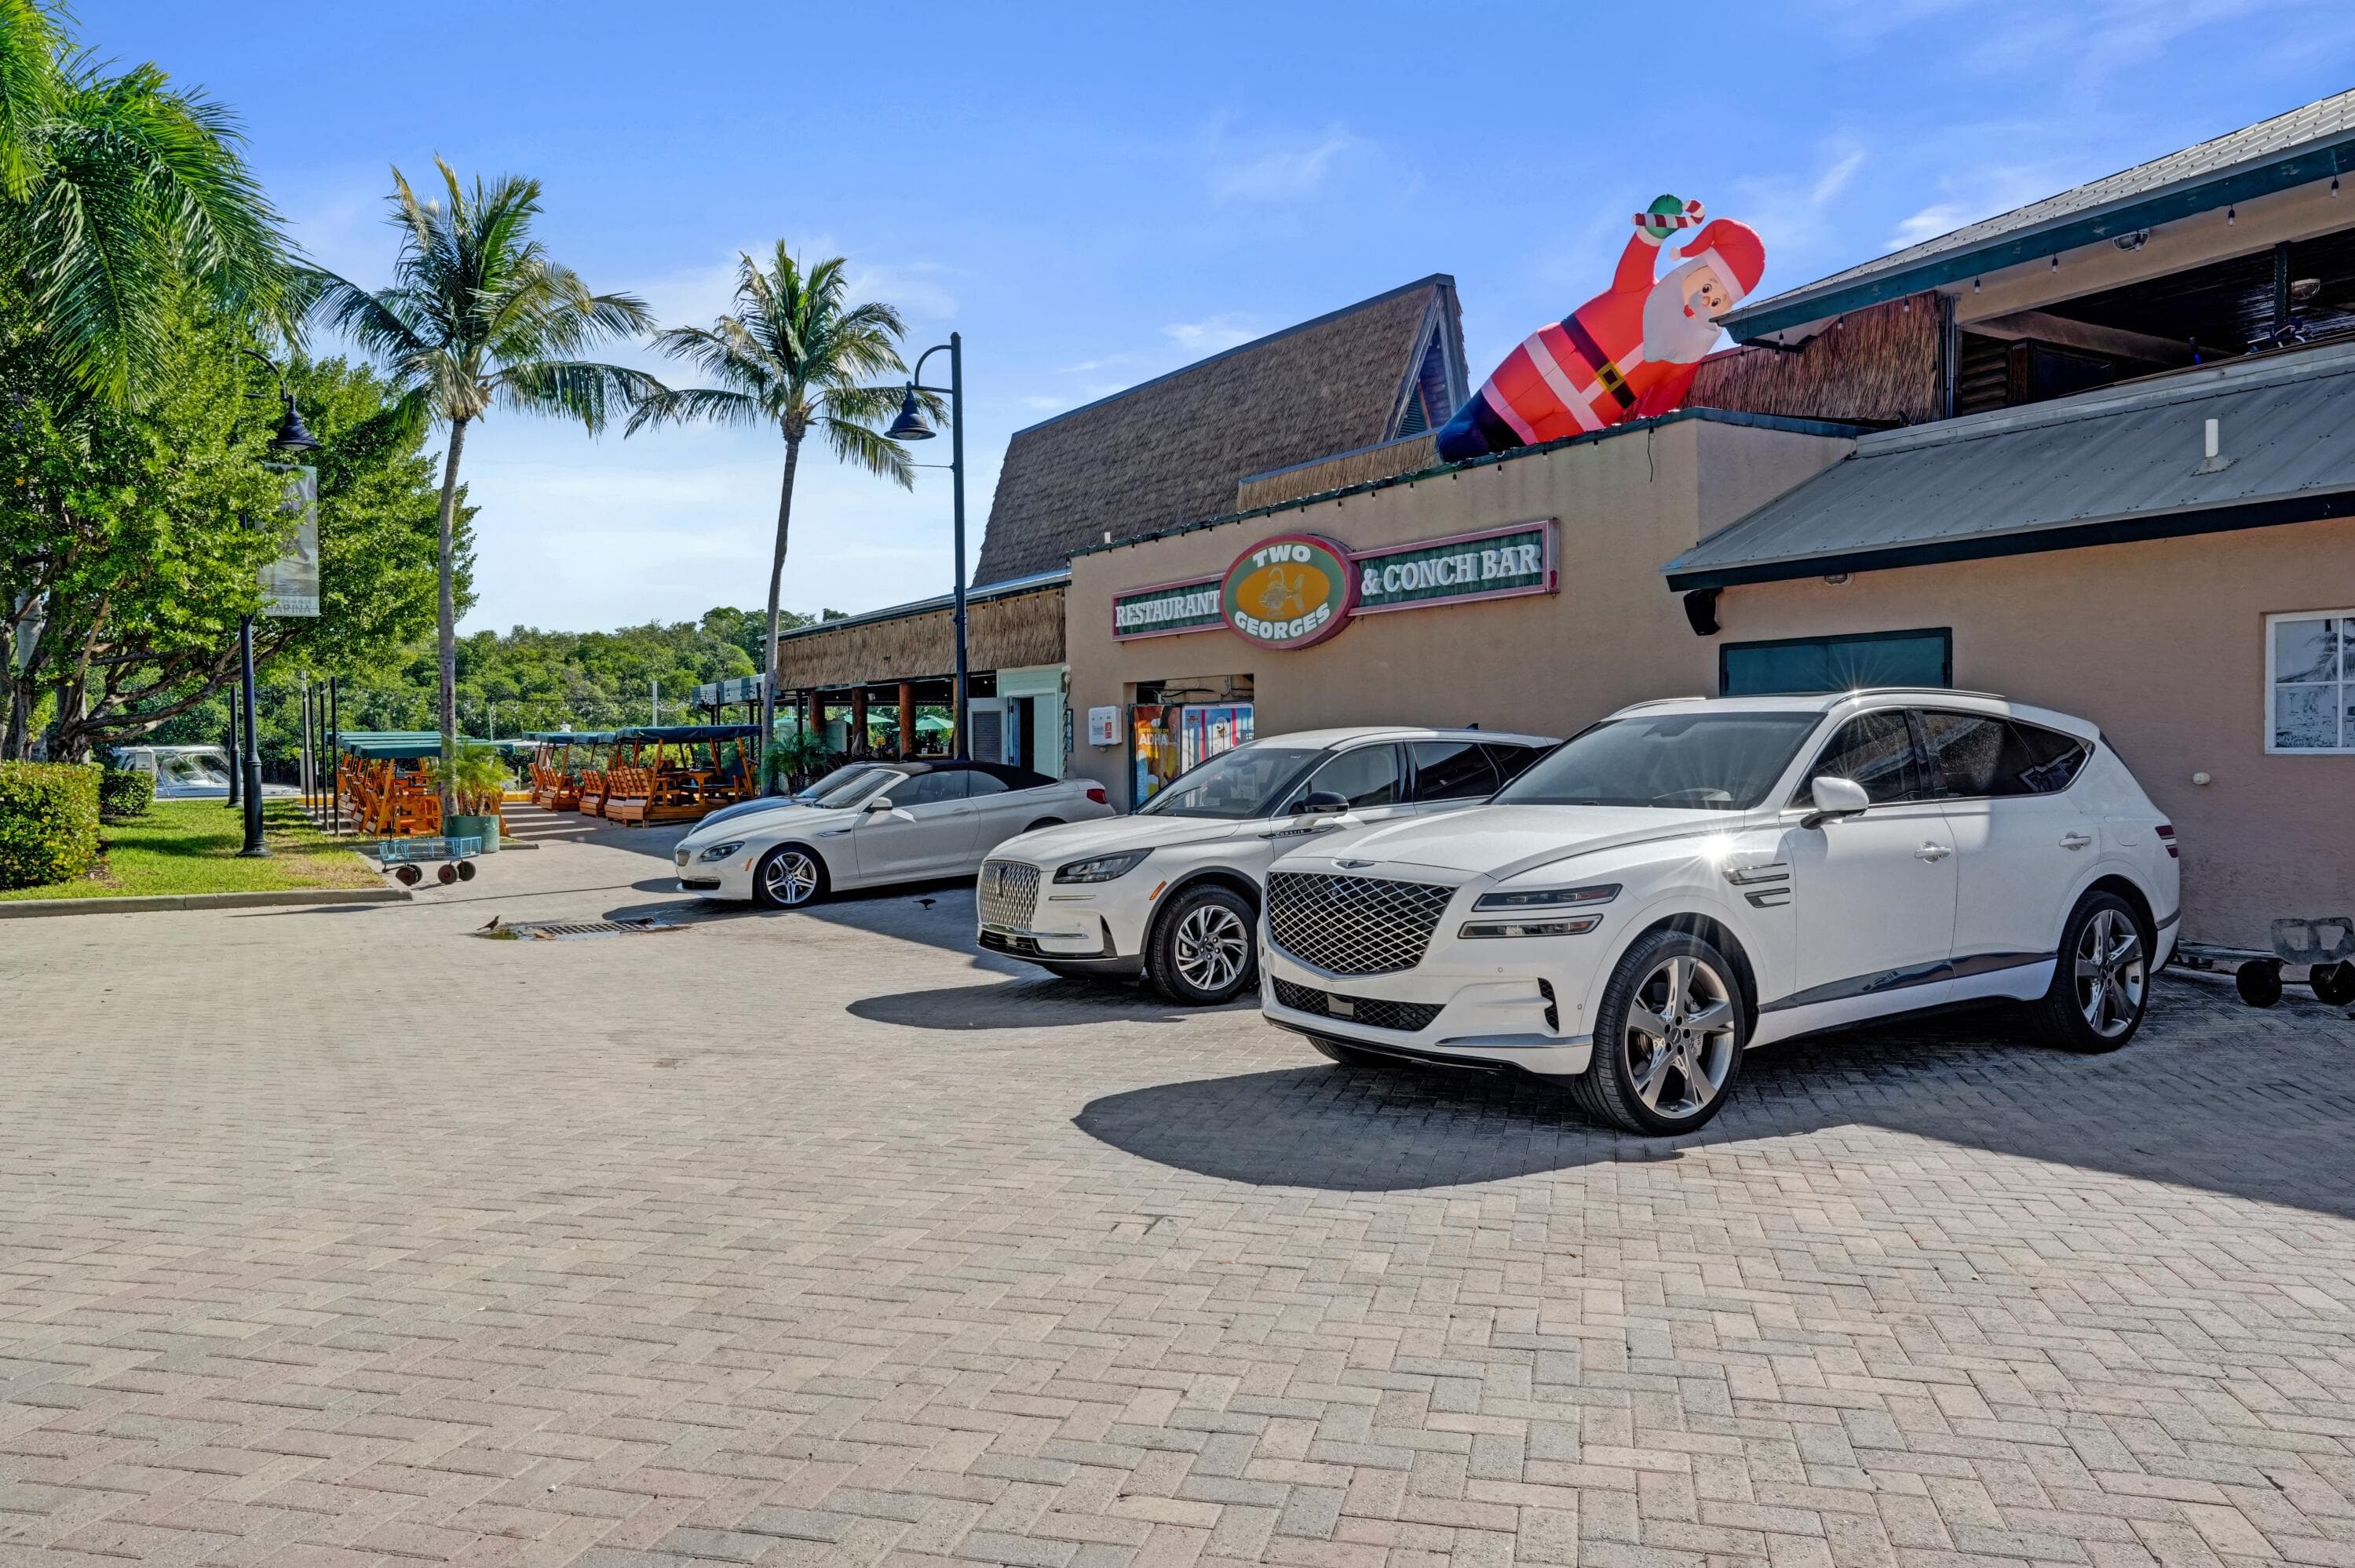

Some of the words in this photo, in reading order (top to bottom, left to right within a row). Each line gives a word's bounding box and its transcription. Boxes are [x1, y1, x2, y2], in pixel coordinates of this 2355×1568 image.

[1253, 545, 1311, 568] TWO
[1361, 568, 1383, 596] &
[1383, 552, 1479, 593] CONCH
[1481, 544, 1543, 580] BAR
[1115, 590, 1220, 627] RESTAURANT
[1235, 603, 1331, 640] GEORGES
